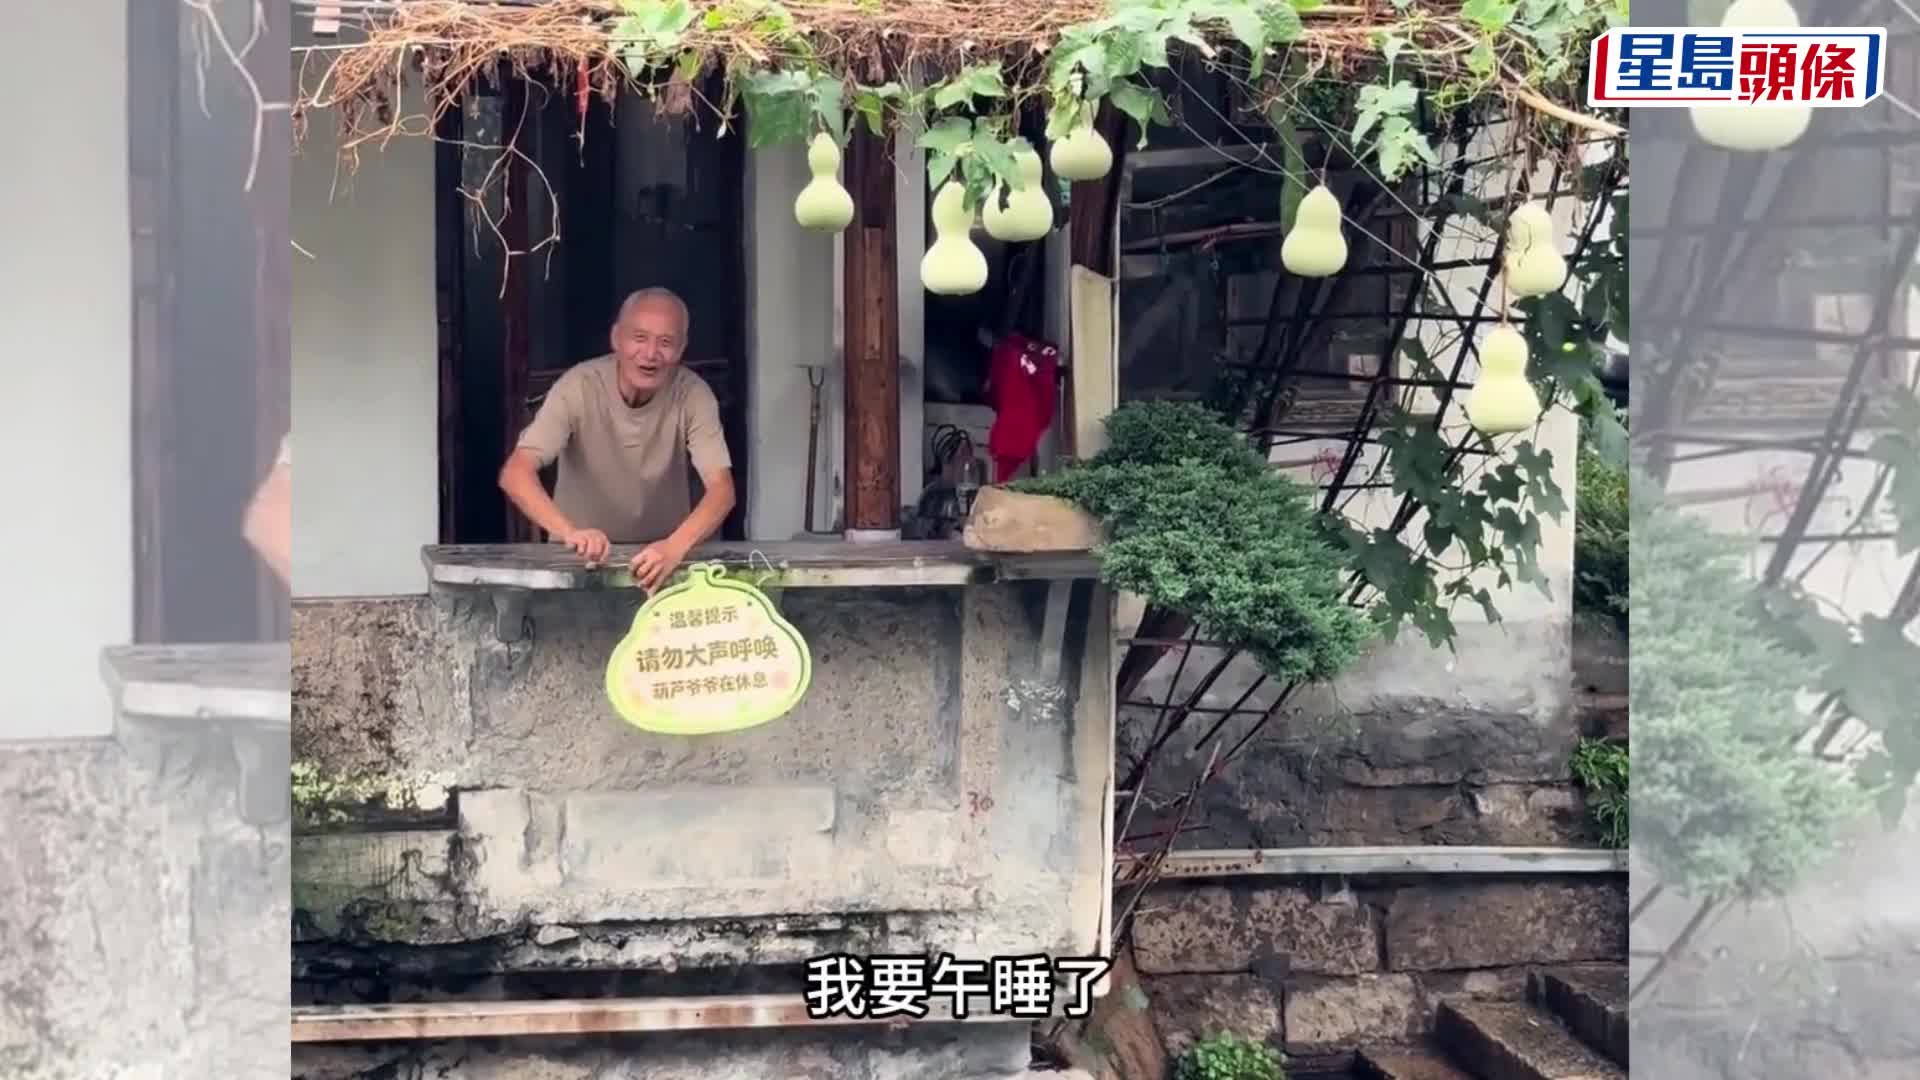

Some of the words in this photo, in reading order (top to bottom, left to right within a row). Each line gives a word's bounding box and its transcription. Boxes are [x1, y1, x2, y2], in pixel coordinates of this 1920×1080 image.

[670, 605, 738, 629] 温馨提示
[636, 635, 778, 672] 请勿大声呼唤
[652, 671, 768, 699] 葫芦爷爷在休息
